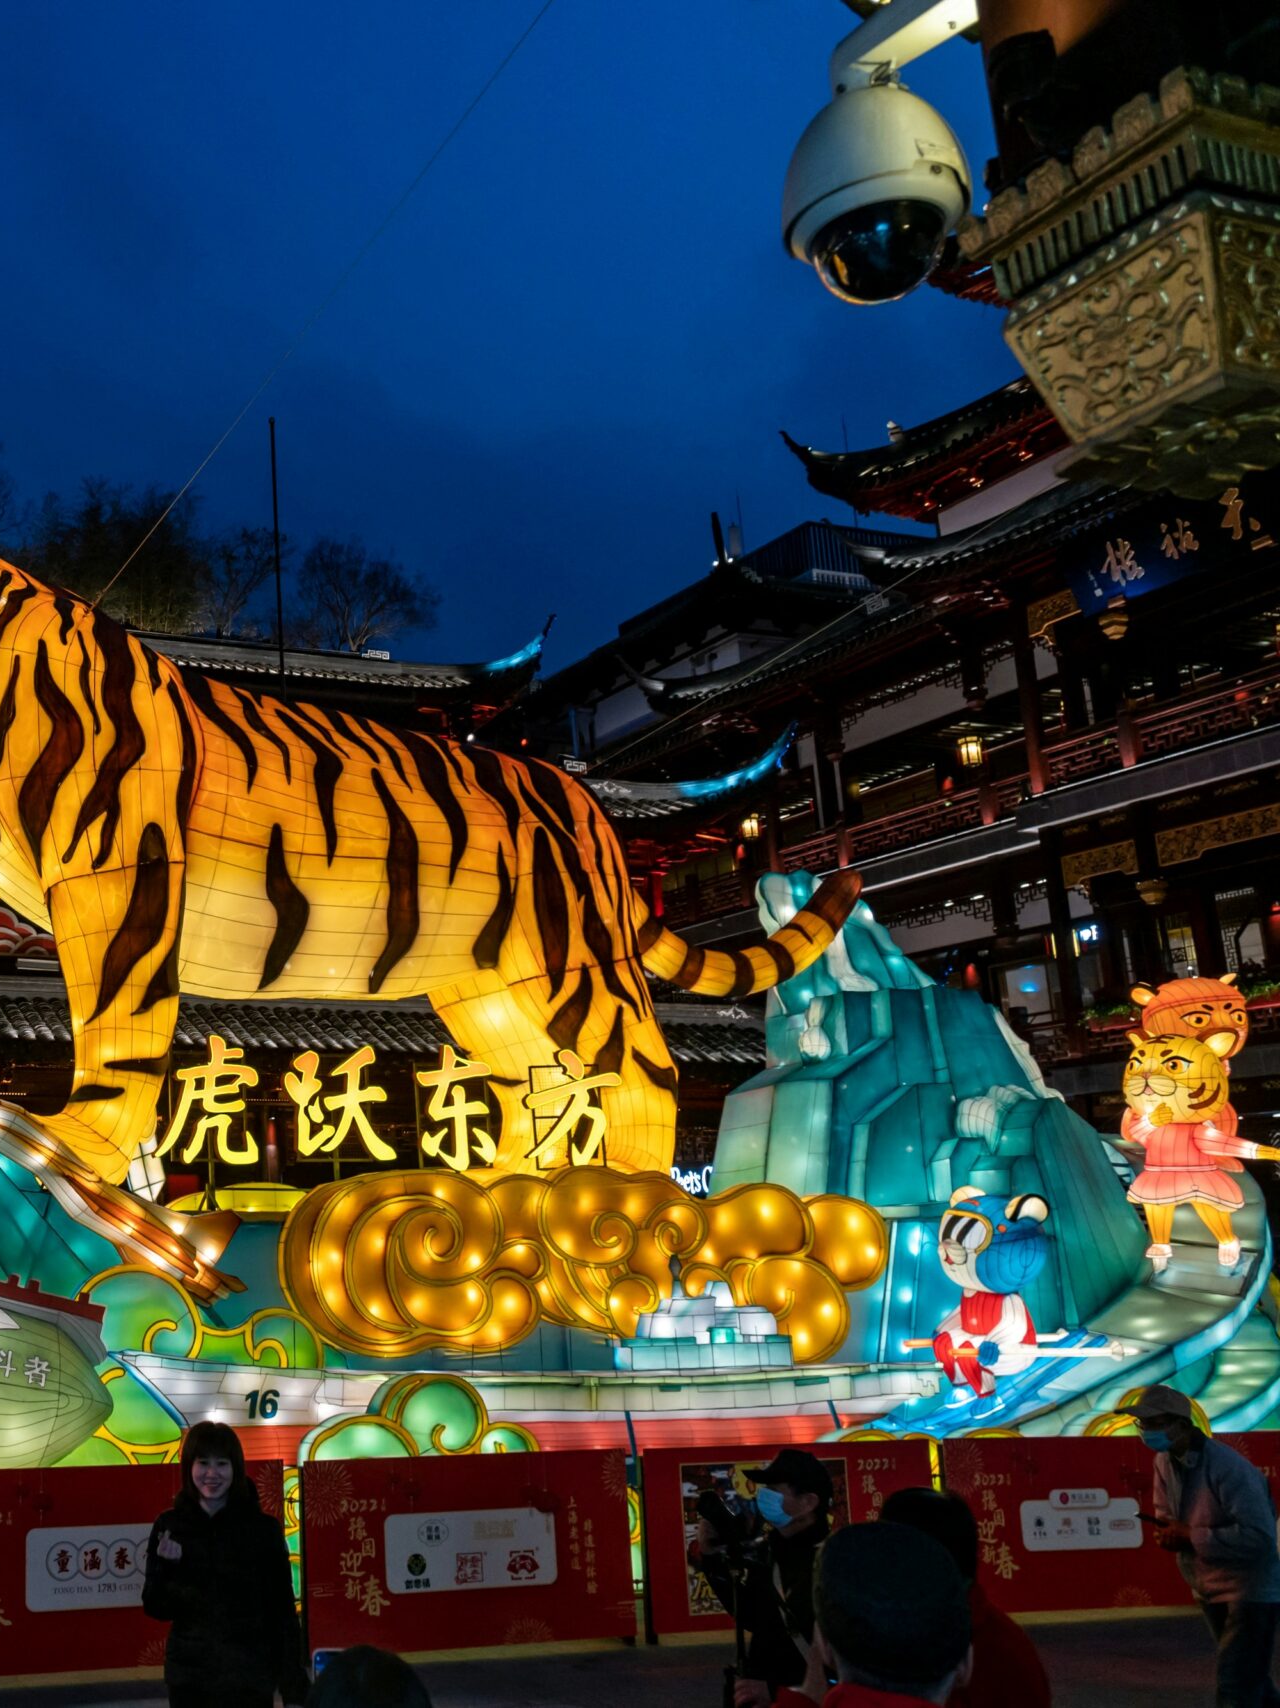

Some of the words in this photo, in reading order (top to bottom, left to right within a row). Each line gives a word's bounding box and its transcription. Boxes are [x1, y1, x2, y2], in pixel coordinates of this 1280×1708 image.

[155, 1034, 623, 1172] 虎跃东方
[244, 1389, 279, 1420] 16
[53, 1546, 146, 1574] 童涵春
[97, 1583, 116, 1594] 1783
